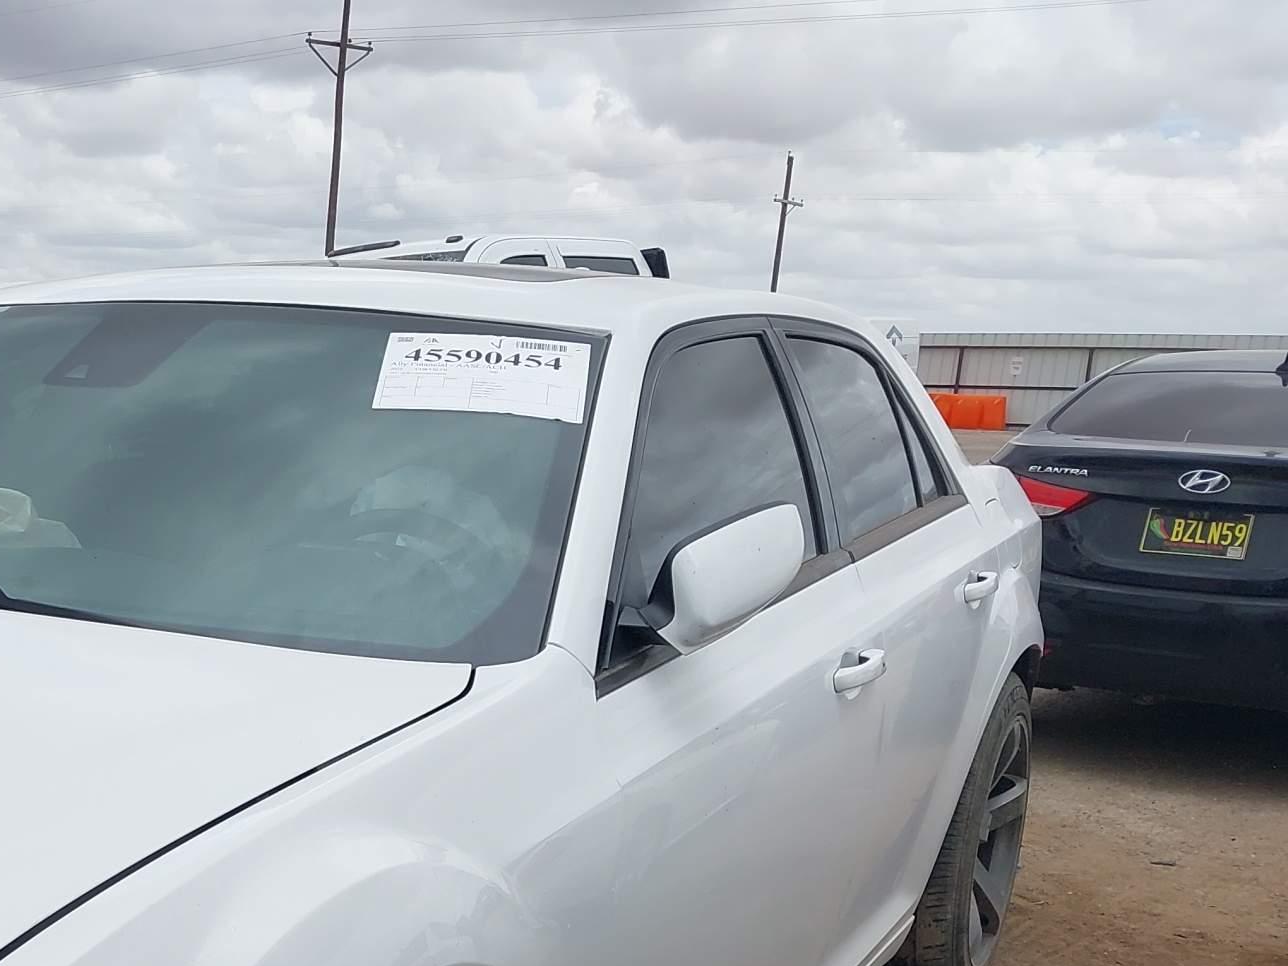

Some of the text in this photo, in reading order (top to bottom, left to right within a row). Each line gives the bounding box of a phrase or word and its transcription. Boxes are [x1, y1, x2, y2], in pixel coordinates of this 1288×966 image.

[404, 347, 563, 371] 45590454
[1028, 465, 1089, 477] ELANTRA
[1170, 518, 1248, 546] BZLN59
